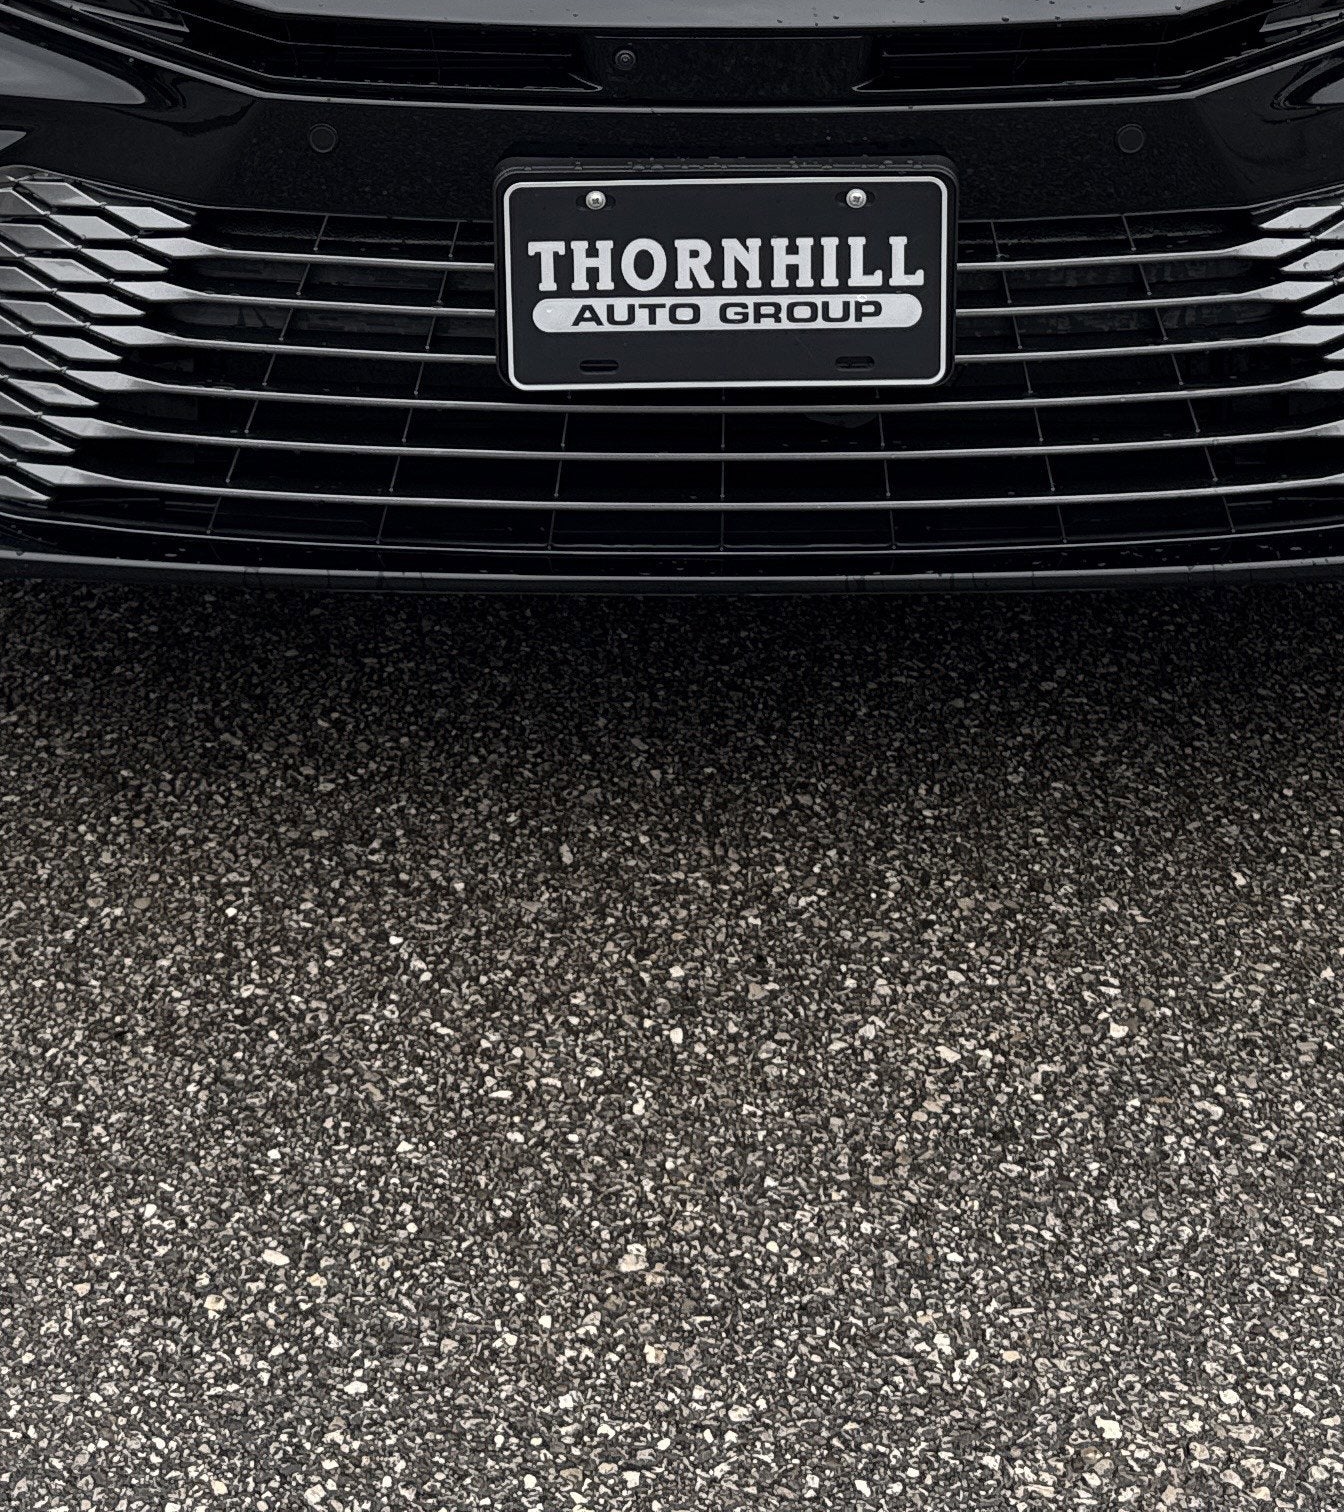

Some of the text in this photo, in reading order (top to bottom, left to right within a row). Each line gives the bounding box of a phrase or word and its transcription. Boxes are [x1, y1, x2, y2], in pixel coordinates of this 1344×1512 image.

[528, 236, 924, 291] THORNHILL
[572, 300, 883, 326] AUTO GROUP
